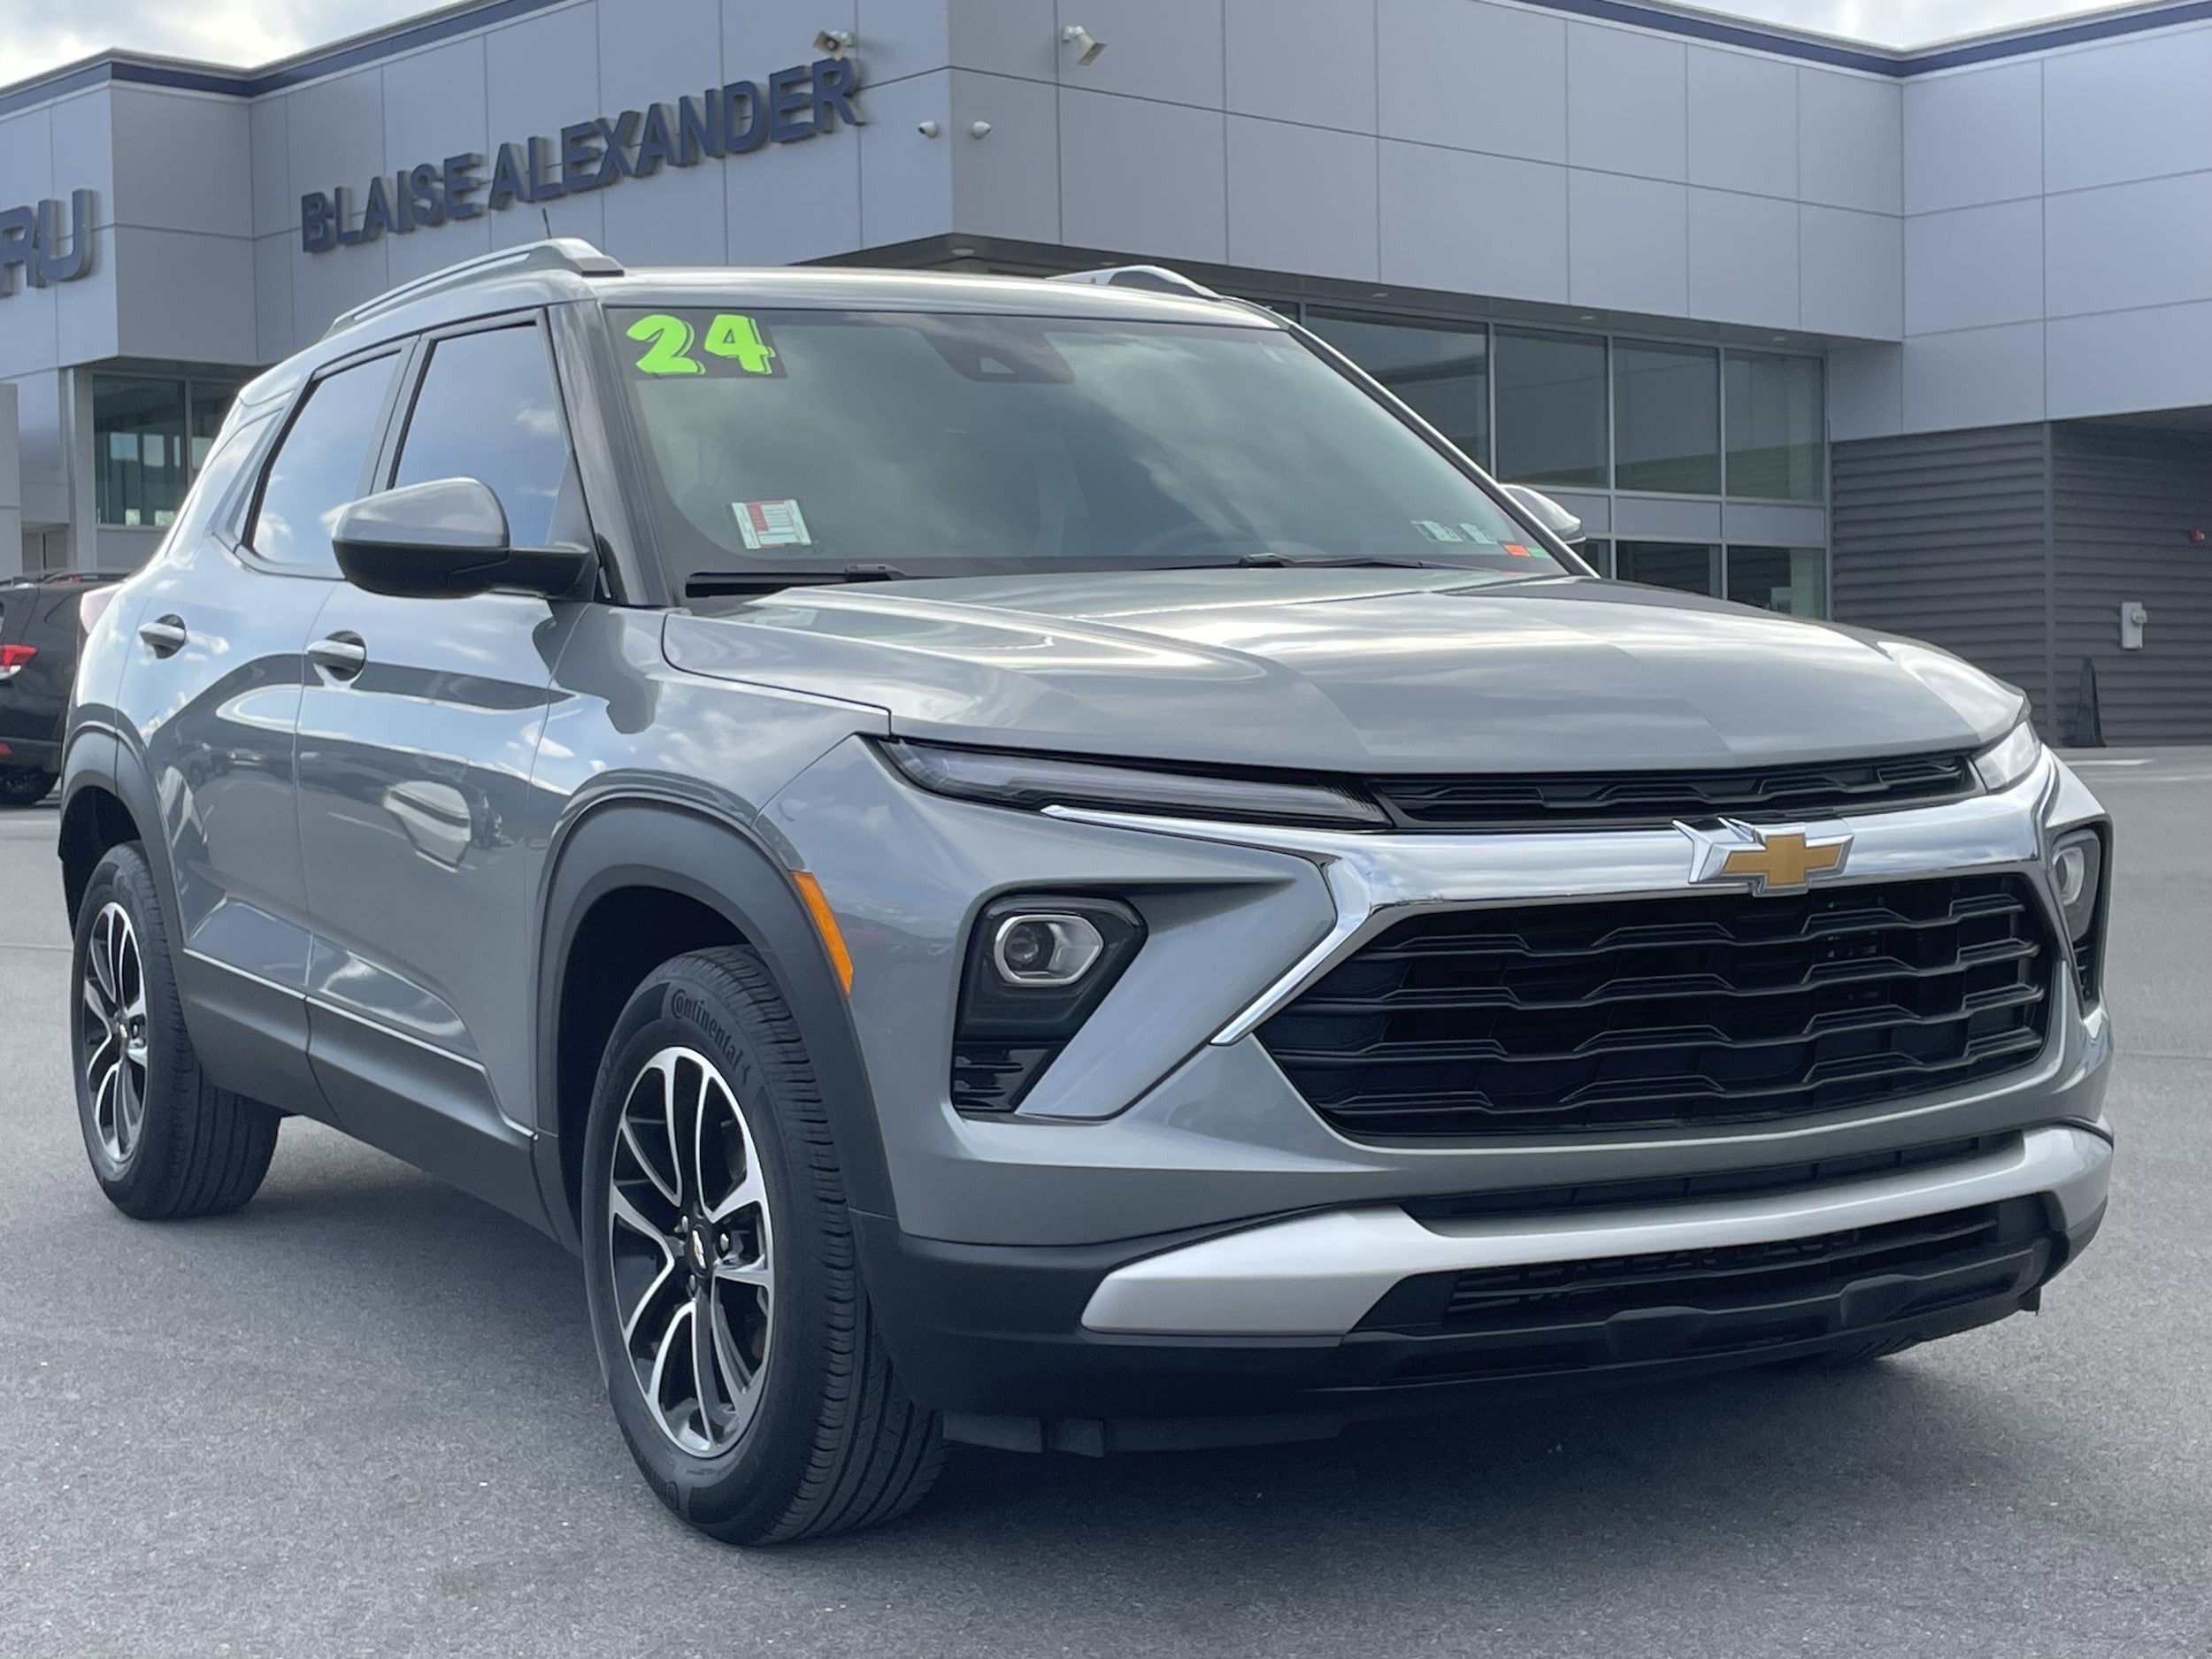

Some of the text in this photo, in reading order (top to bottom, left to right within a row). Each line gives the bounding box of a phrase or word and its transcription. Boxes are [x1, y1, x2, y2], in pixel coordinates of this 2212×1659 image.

[301, 57, 865, 253] BLAISE ALEXANDER
[626, 314, 775, 374] 24
[671, 988, 744, 1071] Continental
